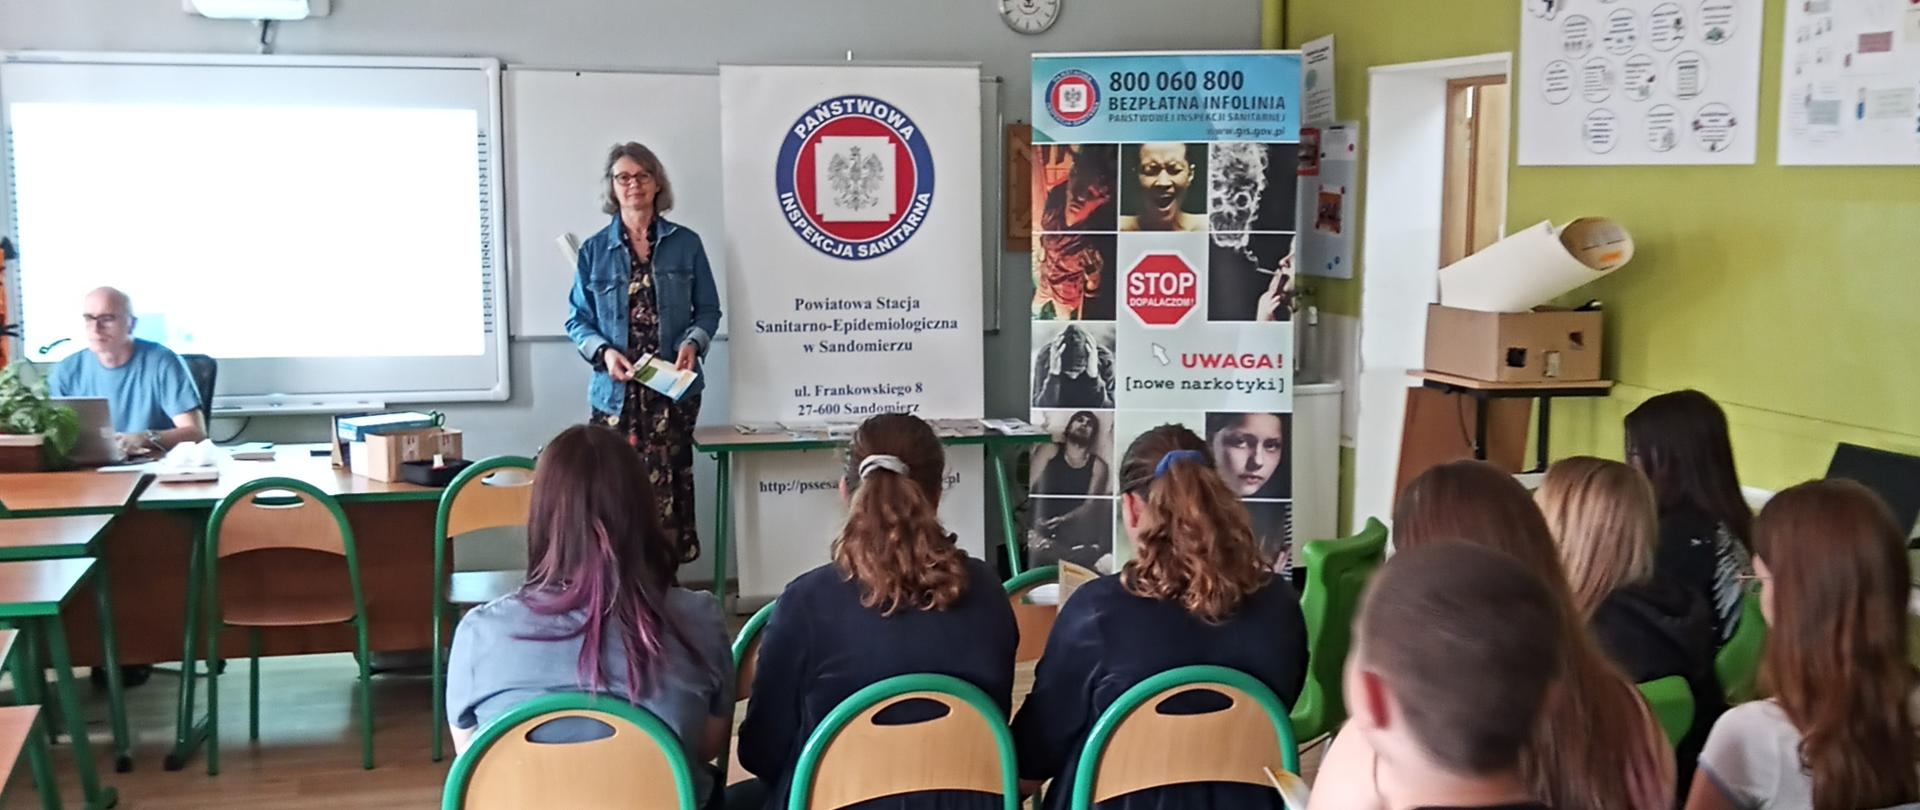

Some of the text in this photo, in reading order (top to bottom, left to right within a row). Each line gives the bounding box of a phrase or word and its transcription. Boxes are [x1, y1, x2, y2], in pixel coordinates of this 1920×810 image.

[1109, 71, 1150, 92] 800
[1156, 71, 1197, 91] 060
[1203, 70, 1244, 91] 800
[1108, 95, 1286, 111] BEZPŁATNA INFOLINIA
[793, 98, 914, 140] PAŃSTWOWA
[780, 191, 931, 258] INSPEKCJA SANITARNA
[1129, 271, 1195, 296] STOP
[794, 296, 920, 312] Powiatowa Stacja
[755, 317, 958, 334] Sanitarno-Epidemiologiczna
[803, 339, 913, 354] w Sandomierzu
[1181, 353, 1284, 369] UWAGA!
[794, 382, 923, 397] ul. Frankowskiego 8
[1126, 376, 1285, 393] [nowe narkotyki]
[798, 402, 920, 416] 27-600 Sandomierz
